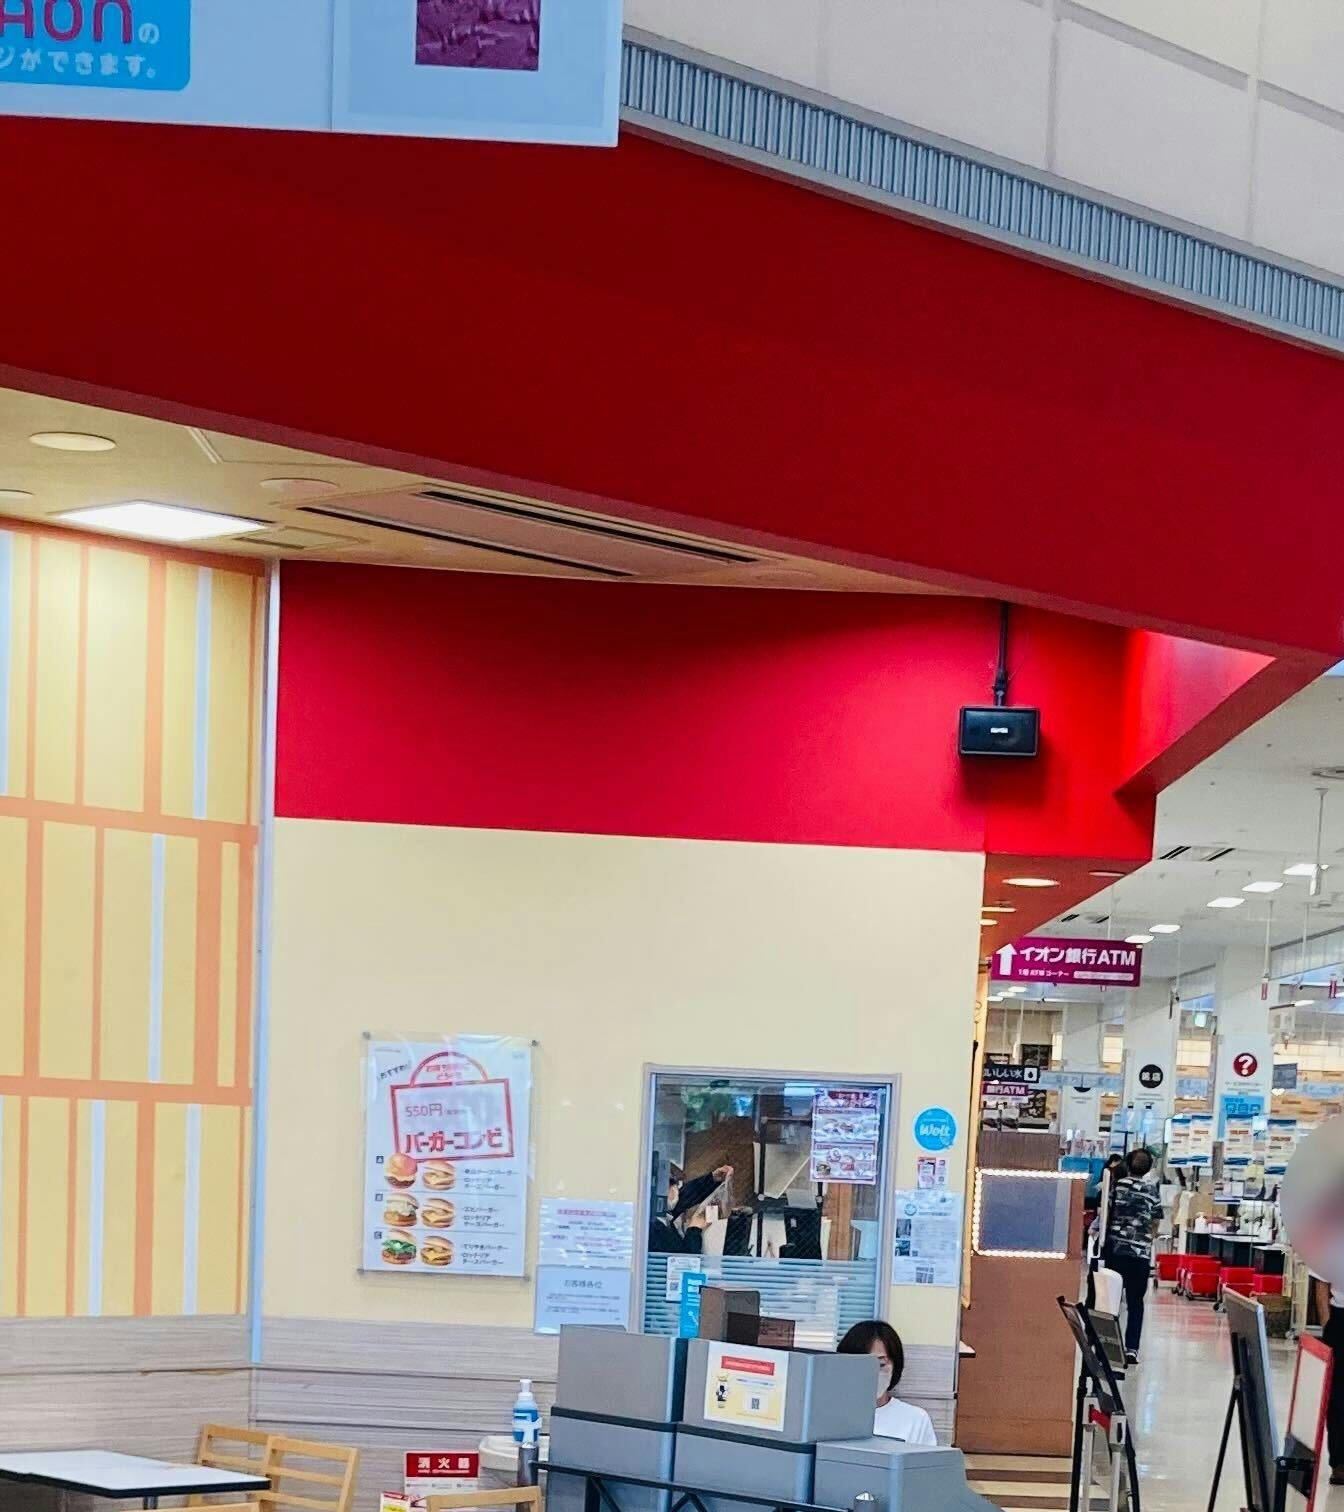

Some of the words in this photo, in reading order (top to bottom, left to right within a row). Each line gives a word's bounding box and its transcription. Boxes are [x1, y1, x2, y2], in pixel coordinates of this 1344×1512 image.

[1019, 946, 1136, 967] イオン銀行ATM
[405, 1103, 443, 1118] 550円
[406, 1128, 504, 1153] バーガーコンビ
[417, 1457, 470, 1469] 消火器
